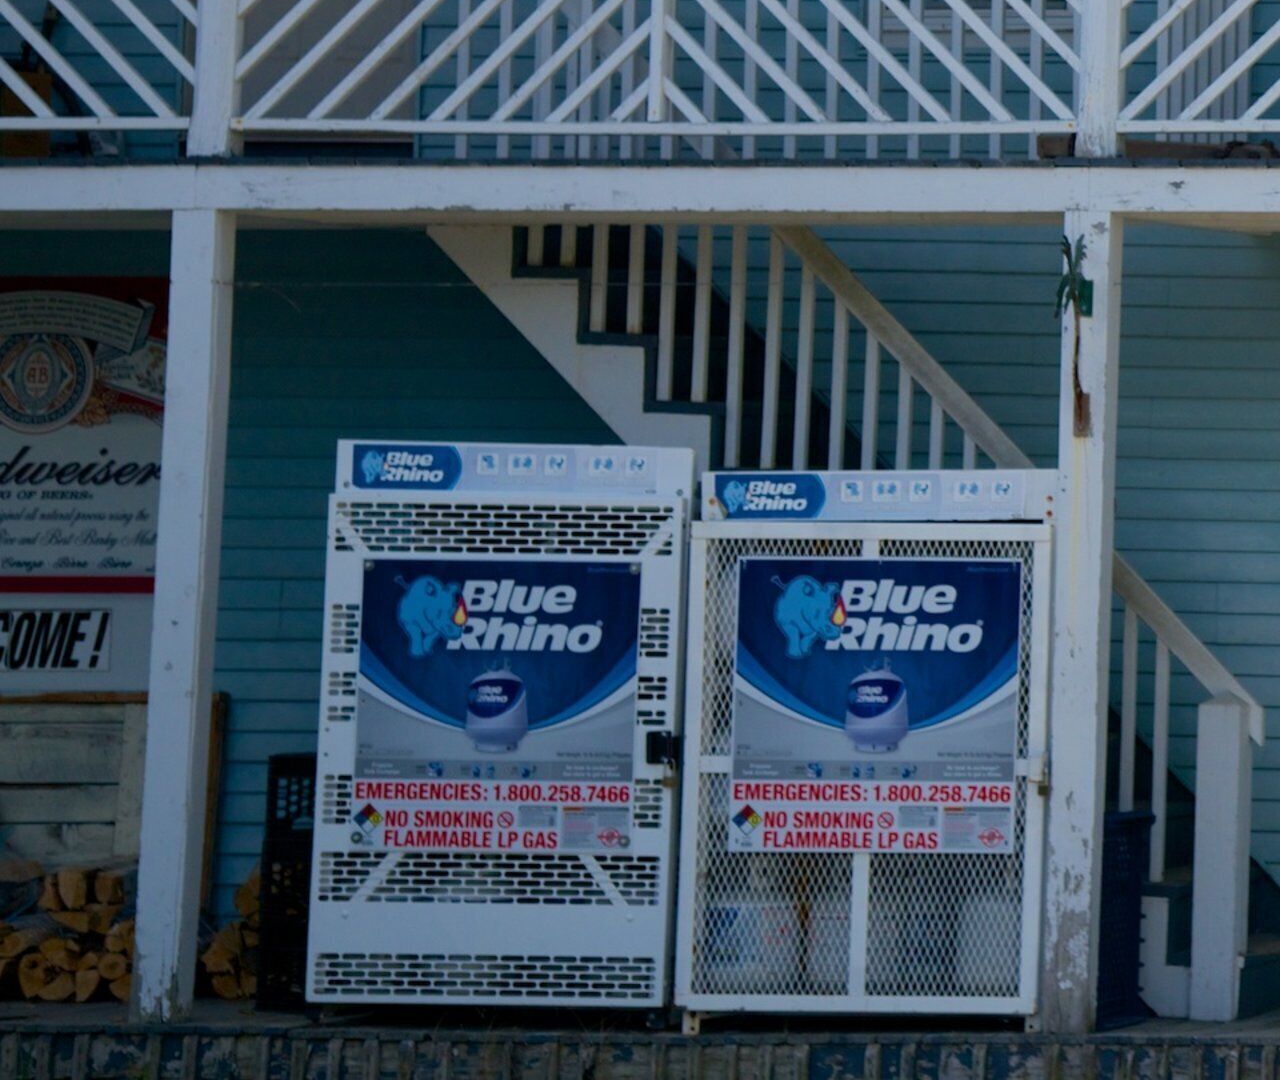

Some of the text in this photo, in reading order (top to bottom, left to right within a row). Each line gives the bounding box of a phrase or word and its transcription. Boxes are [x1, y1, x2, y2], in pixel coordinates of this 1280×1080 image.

[0, 445, 161, 486] dweiser
[385, 451, 434, 468] Blue
[379, 468, 444, 484] Rhino
[748, 480, 797, 496] Blue
[743, 496, 808, 512] Rhino
[462, 578, 578, 615] Blue
[840, 578, 958, 615] Blue
[446, 615, 603, 654] Rhino
[825, 615, 984, 654] Rhino
[354, 781, 630, 803] EMERGENCIES: 1.800.258.7466
[733, 783, 1011, 803] EMERGENCIES: 1.800.258.7466
[384, 810, 494, 829] NO SMOKING
[763, 811, 874, 830] NO SMOKING
[383, 829, 558, 850] FLAMMABLE LP GAS
[762, 830, 938, 850] FLAMMABLE LP GAS
